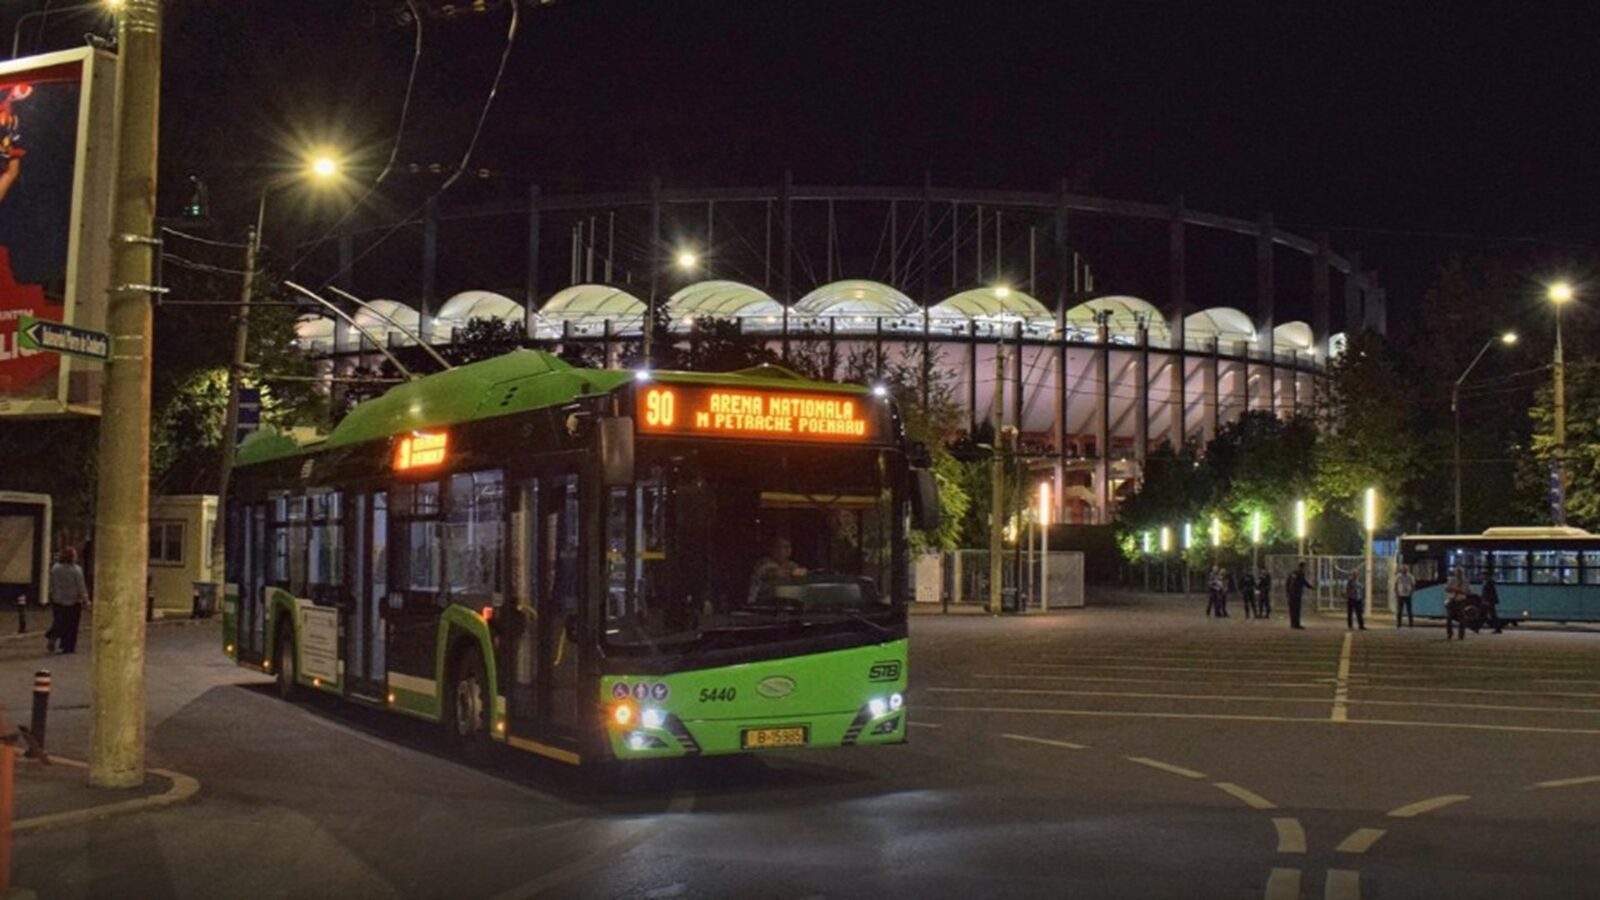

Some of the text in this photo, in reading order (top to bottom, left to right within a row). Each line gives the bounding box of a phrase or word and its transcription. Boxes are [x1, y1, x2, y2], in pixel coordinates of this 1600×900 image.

[646, 390, 674, 426] 90
[710, 393, 853, 419] ARENA NATIONALA
[696, 412, 865, 435] M PETRACHE POENARU
[868, 662, 900, 680] STB
[698, 686, 736, 703] 5440
